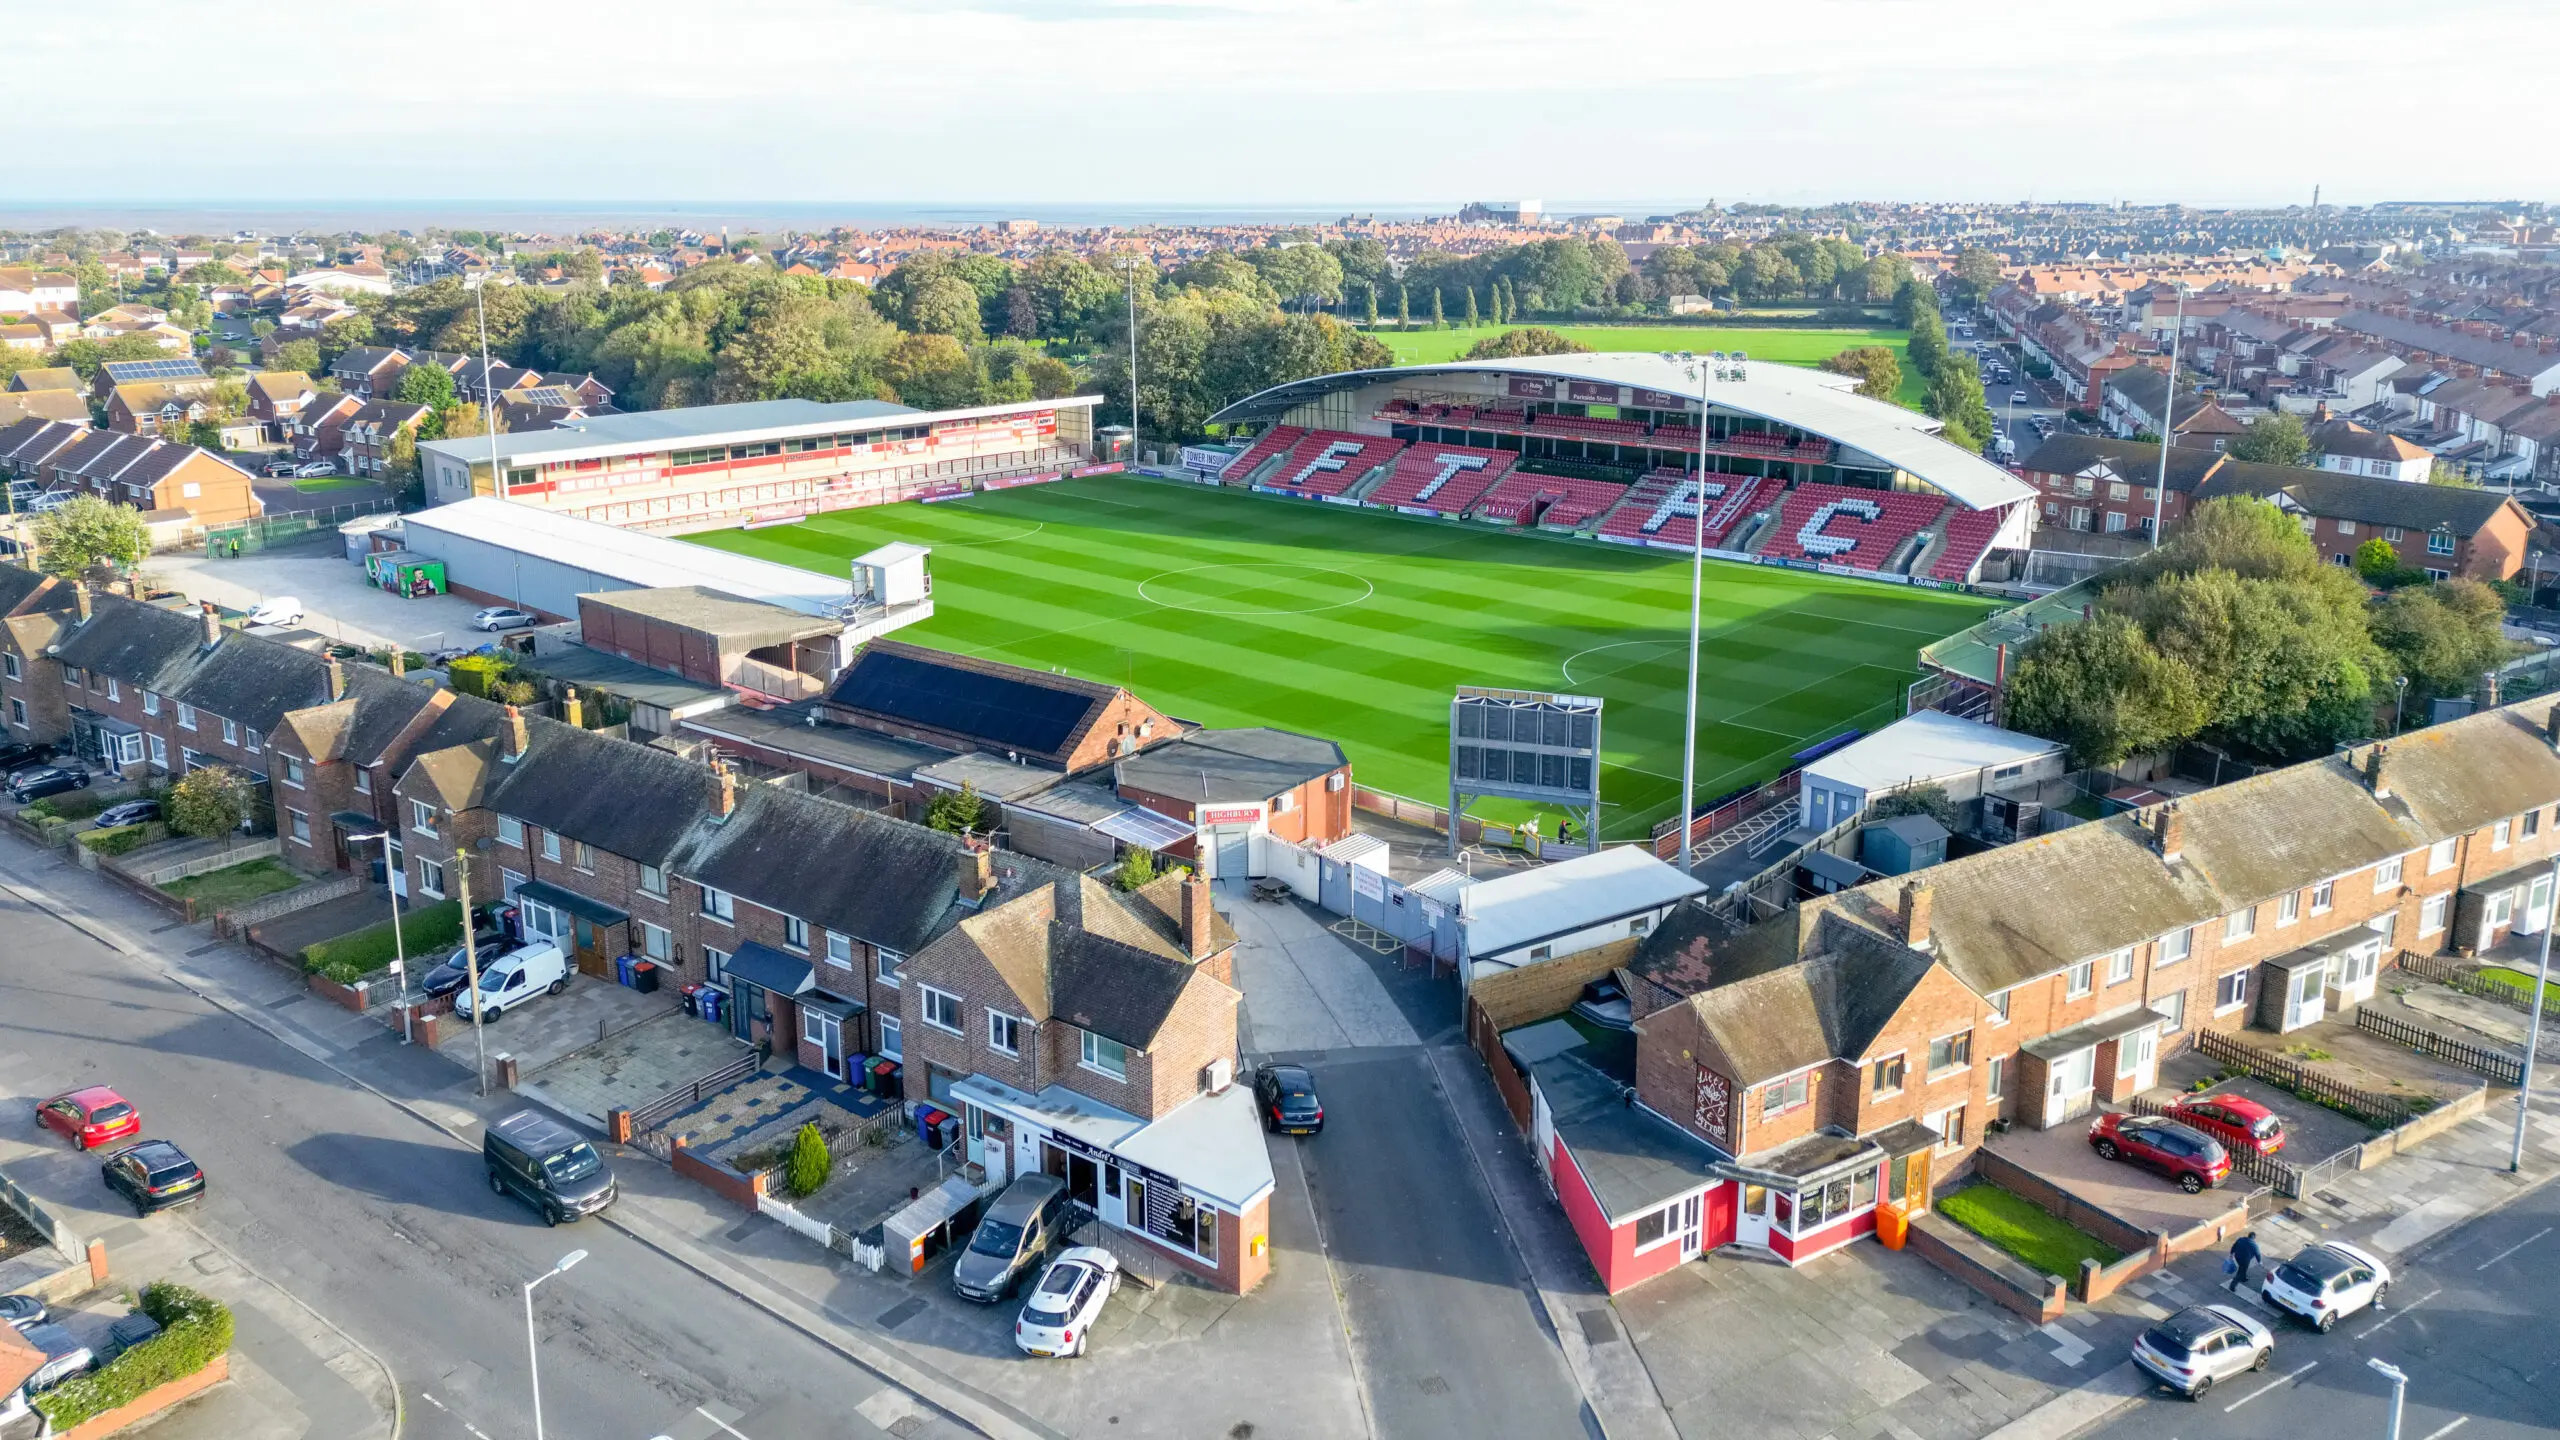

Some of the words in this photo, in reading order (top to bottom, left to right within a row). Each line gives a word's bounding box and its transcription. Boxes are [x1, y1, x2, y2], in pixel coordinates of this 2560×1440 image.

[1573, 393, 1596, 401] Parkside
[1186, 450, 1205, 463] TOWER
[1291, 441, 1365, 484] F
[1414, 453, 1490, 501] T
[1641, 480, 1727, 532] F
[1797, 498, 1883, 556] C
[1913, 576, 1957, 590] QUINNBET
[1211, 810, 1254, 819] HIGHBURY
